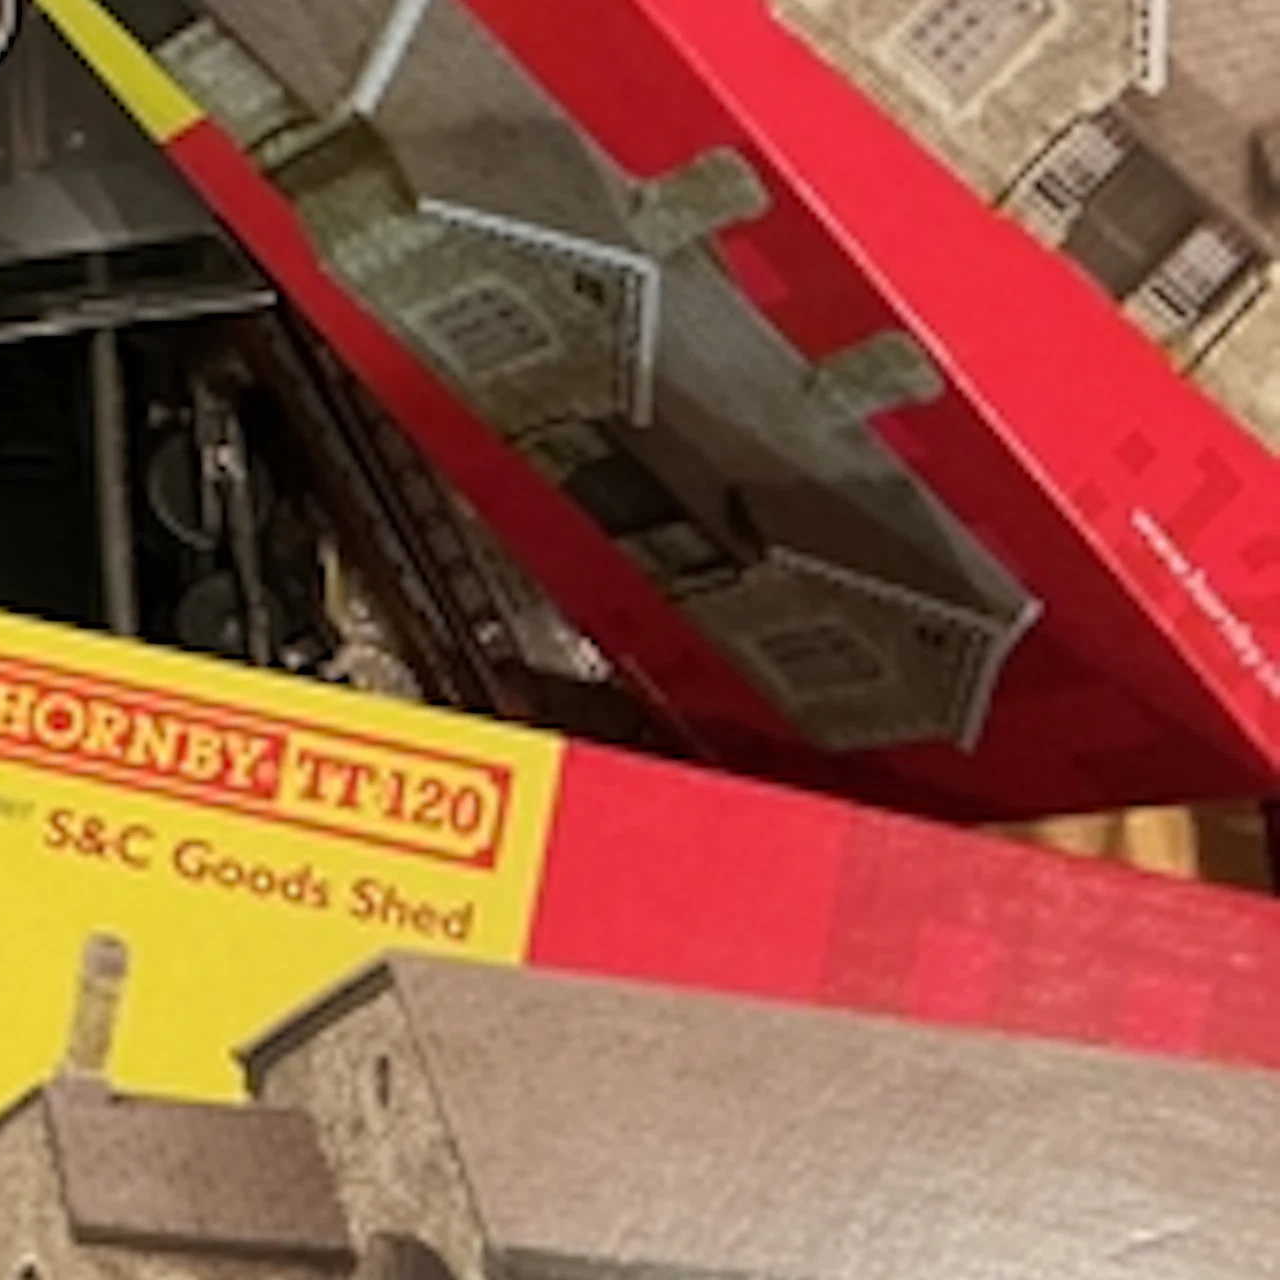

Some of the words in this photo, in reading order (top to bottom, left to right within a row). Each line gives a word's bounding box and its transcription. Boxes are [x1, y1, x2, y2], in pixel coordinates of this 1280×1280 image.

[43, 809, 157, 872] S&C
[173, 839, 329, 910] Goods
[349, 876, 476, 942] Shed
